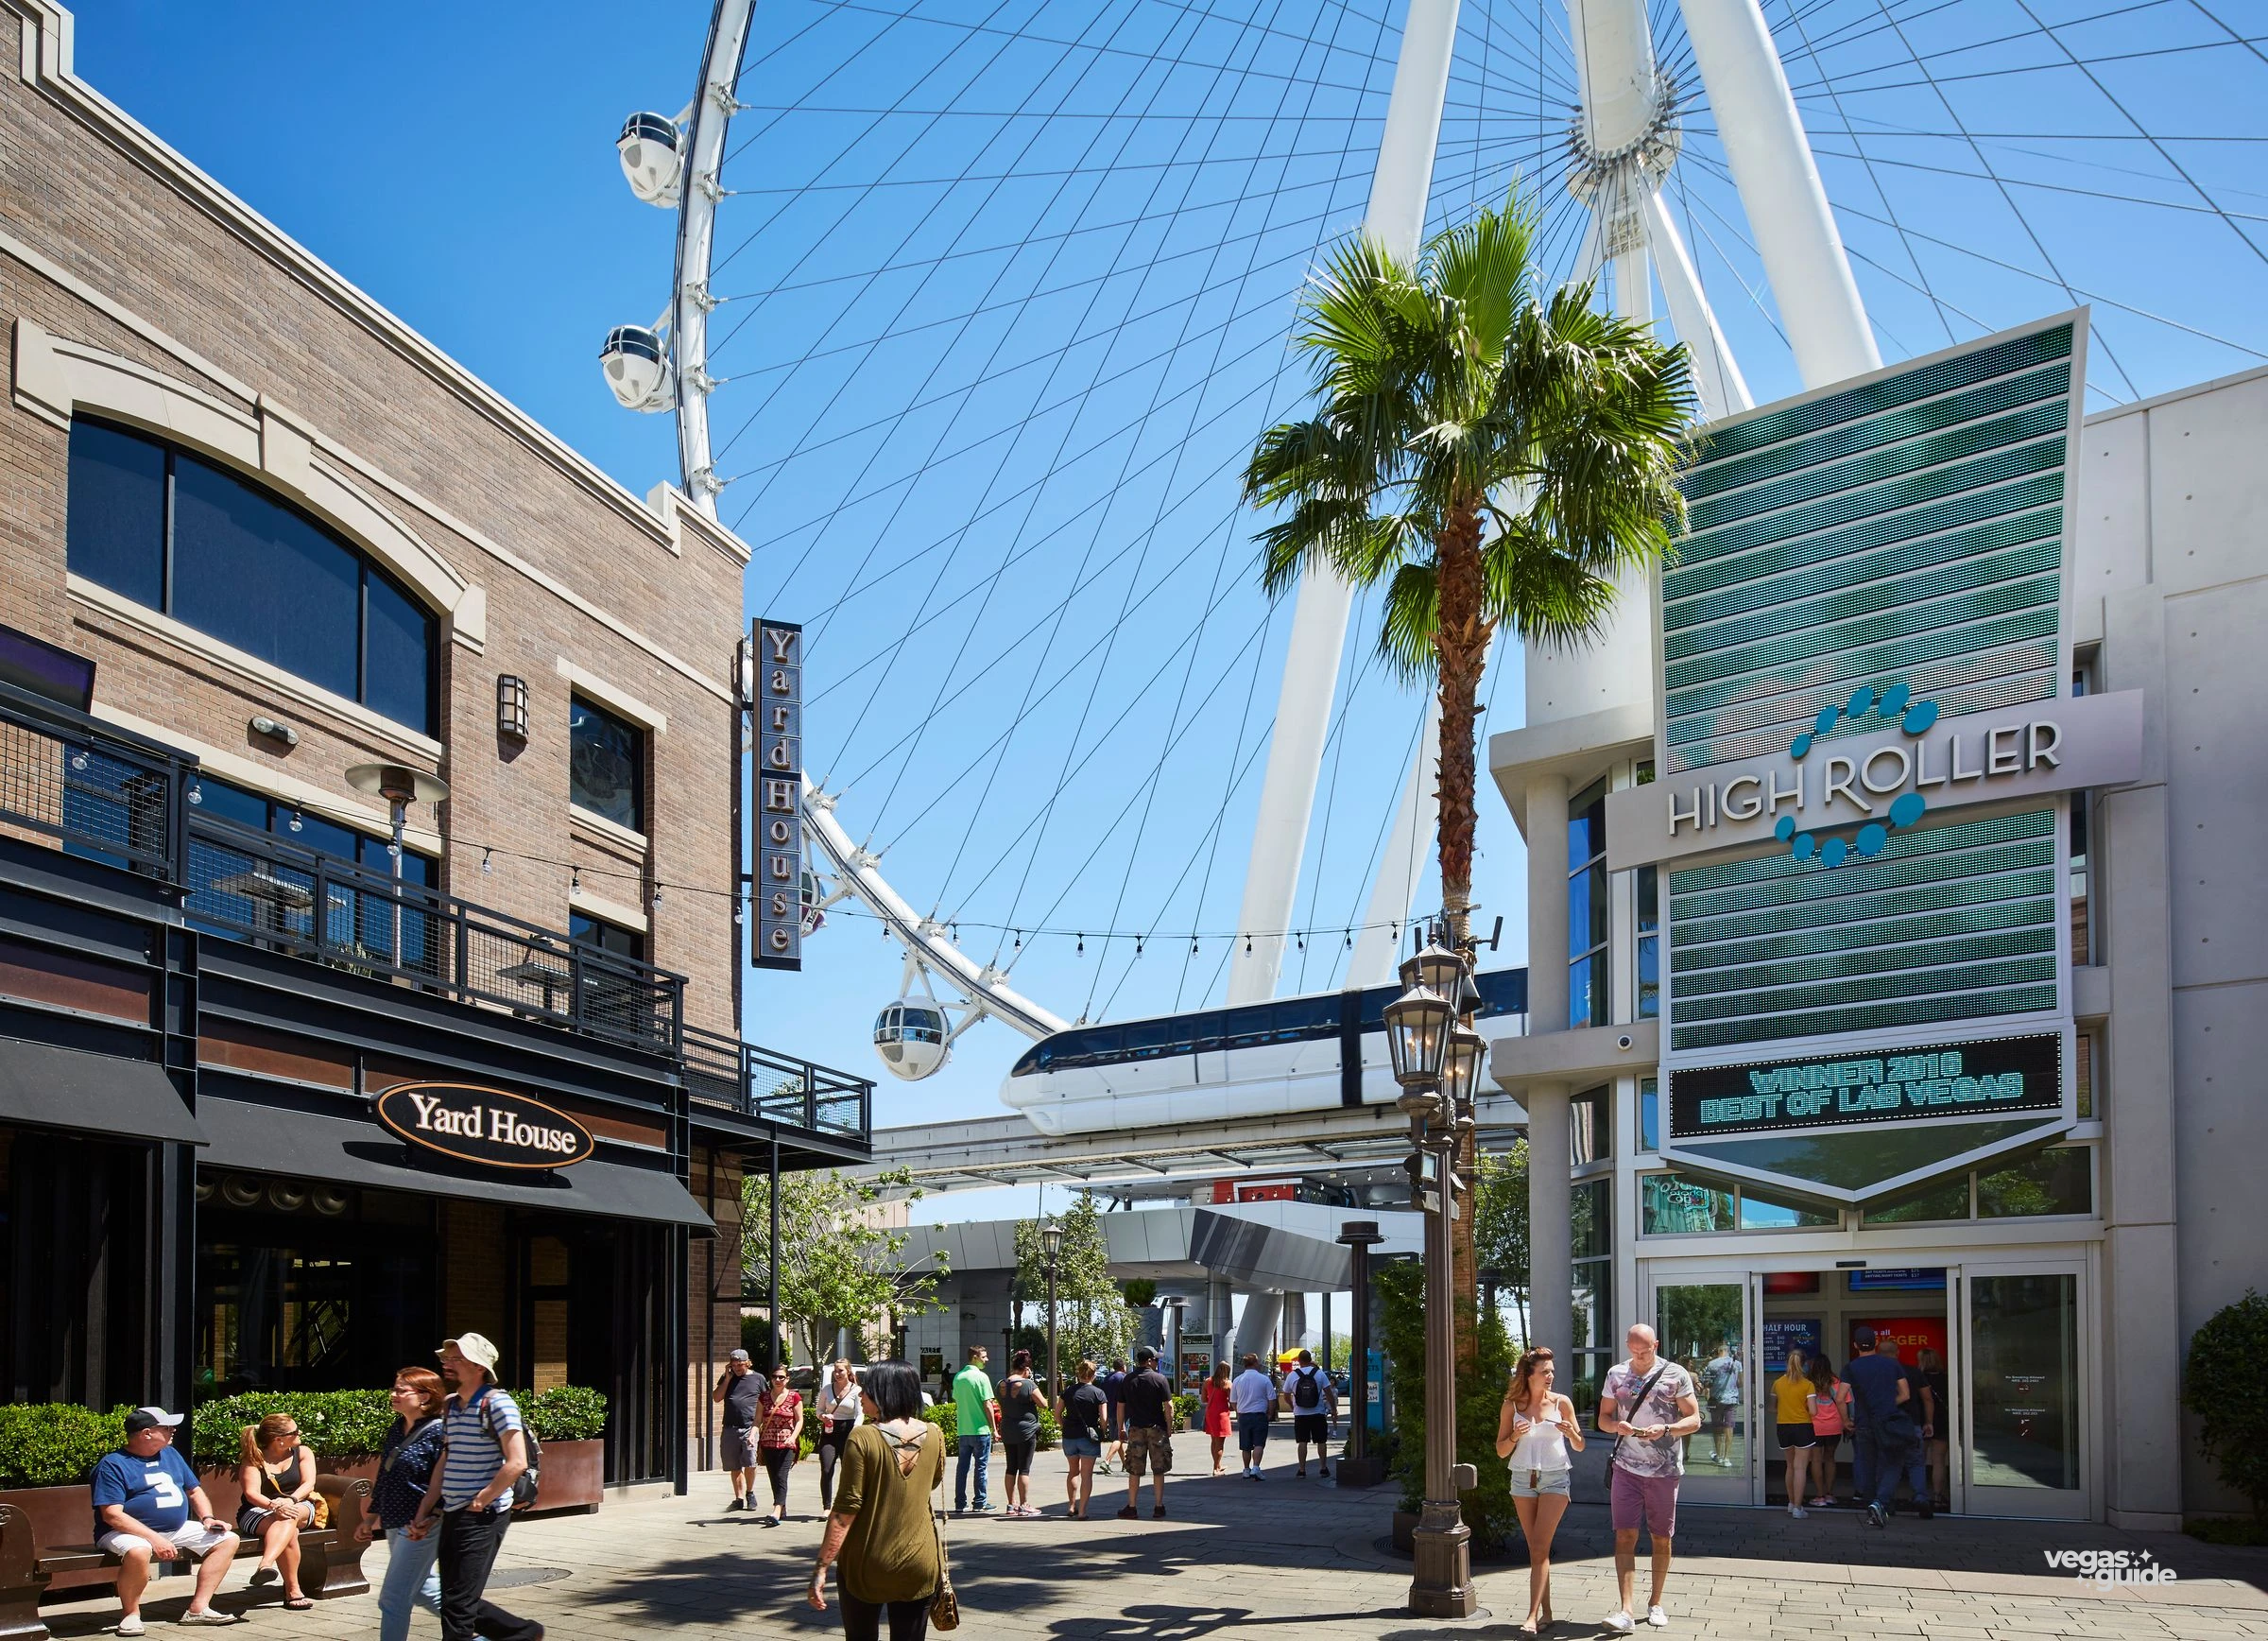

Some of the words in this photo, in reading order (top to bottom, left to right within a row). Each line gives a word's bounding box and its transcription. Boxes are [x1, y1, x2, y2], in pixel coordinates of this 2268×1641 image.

[767, 629, 795, 770] Yard
[1668, 763, 1804, 837] HIGH
[1824, 720, 2063, 814] ROLLER
[766, 780, 795, 950] House
[1700, 1094, 1782, 1124] BEST
[1786, 1089, 1832, 1116] OF
[1838, 1083, 1901, 1113] LAS
[1904, 1072, 2024, 1106] VEGAS
[1748, 1059, 1884, 1094] WINNER
[408, 1092, 484, 1139] Yard
[488, 1108, 577, 1155] House
[1784, 1323, 1807, 1332] HOUR
[145, 1471, 183, 1509] 3
